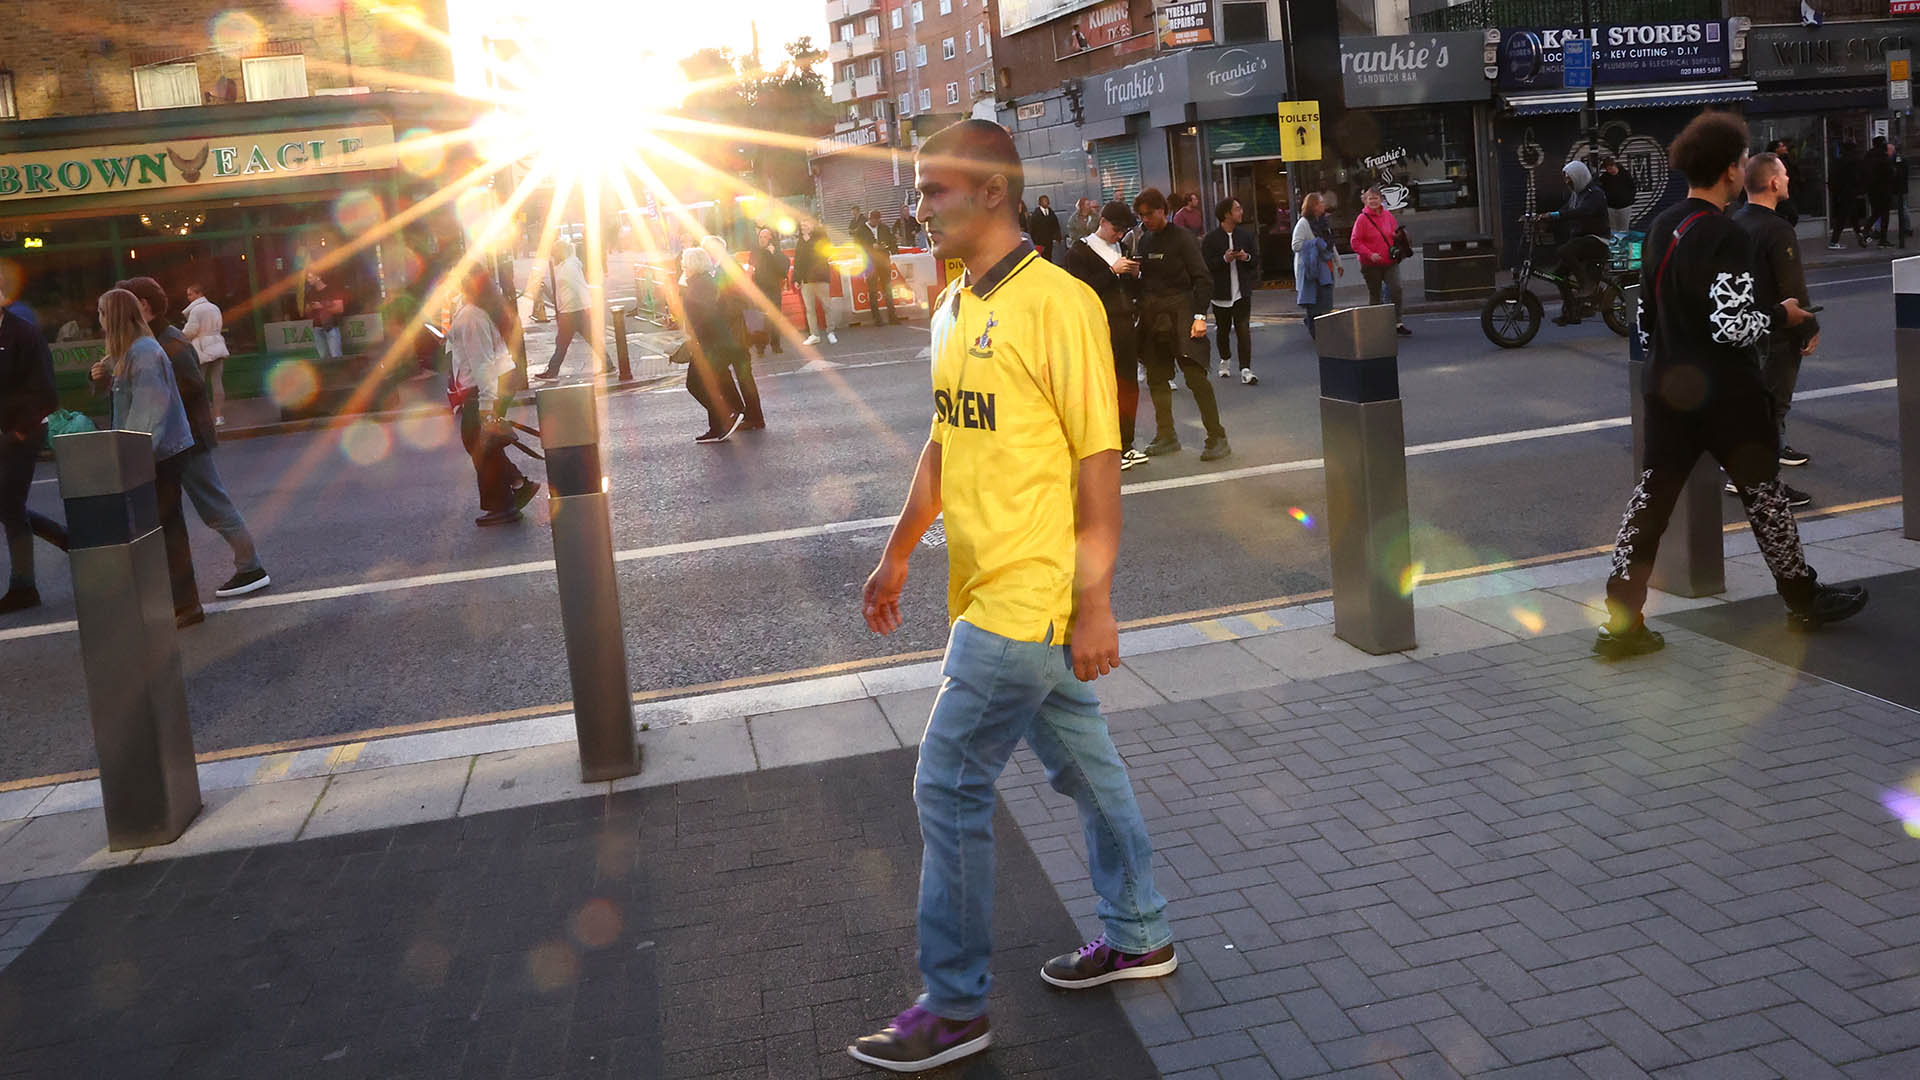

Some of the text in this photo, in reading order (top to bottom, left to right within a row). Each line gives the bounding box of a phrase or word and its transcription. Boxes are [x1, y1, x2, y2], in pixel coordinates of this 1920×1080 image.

[1165, 2, 1207, 18] TYRES & AUTO
[1893, 3, 1907, 12] LET
[1168, 15, 1196, 29] REPAIRS
[1608, 24, 1701, 46] STORES
[1610, 49, 1627, 59] KEY
[1629, 47, 1668, 59] CUTTING
[1677, 46, 1699, 57] D.I.Y
[1206, 56, 1267, 86] Frankie's
[1357, 72, 1417, 85] SANDWICH BAR
[1104, 65, 1165, 105] Frankie's
[1279, 113, 1320, 124] TOILETS
[210, 137, 368, 177] EAGLE
[1364, 146, 1406, 168] Frankie's
[0, 152, 168, 195] BROWN
